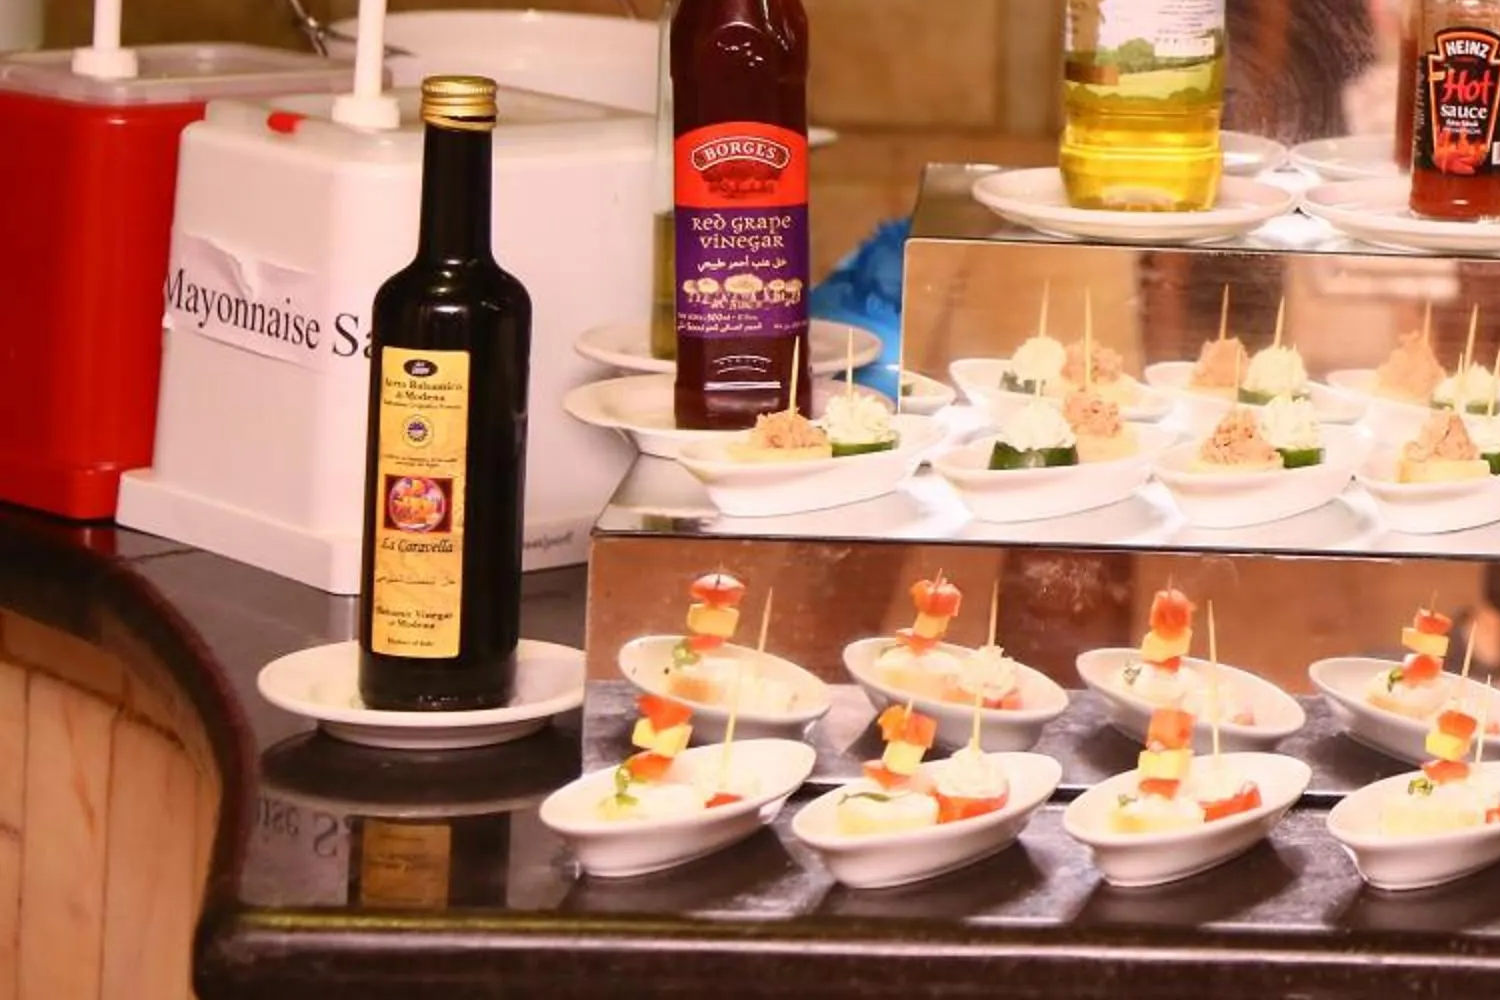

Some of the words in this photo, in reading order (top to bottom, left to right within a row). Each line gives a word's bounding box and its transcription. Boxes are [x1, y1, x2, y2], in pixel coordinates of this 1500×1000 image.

[1445, 39, 1491, 59] HEINZ
[1440, 66, 1495, 106] Hot
[1440, 103, 1489, 119] sauce
[703, 140, 777, 161] BORGES
[165, 267, 320, 349] Mayonnaise
[332, 312, 373, 358] S
[397, 539, 454, 553] Caravella
